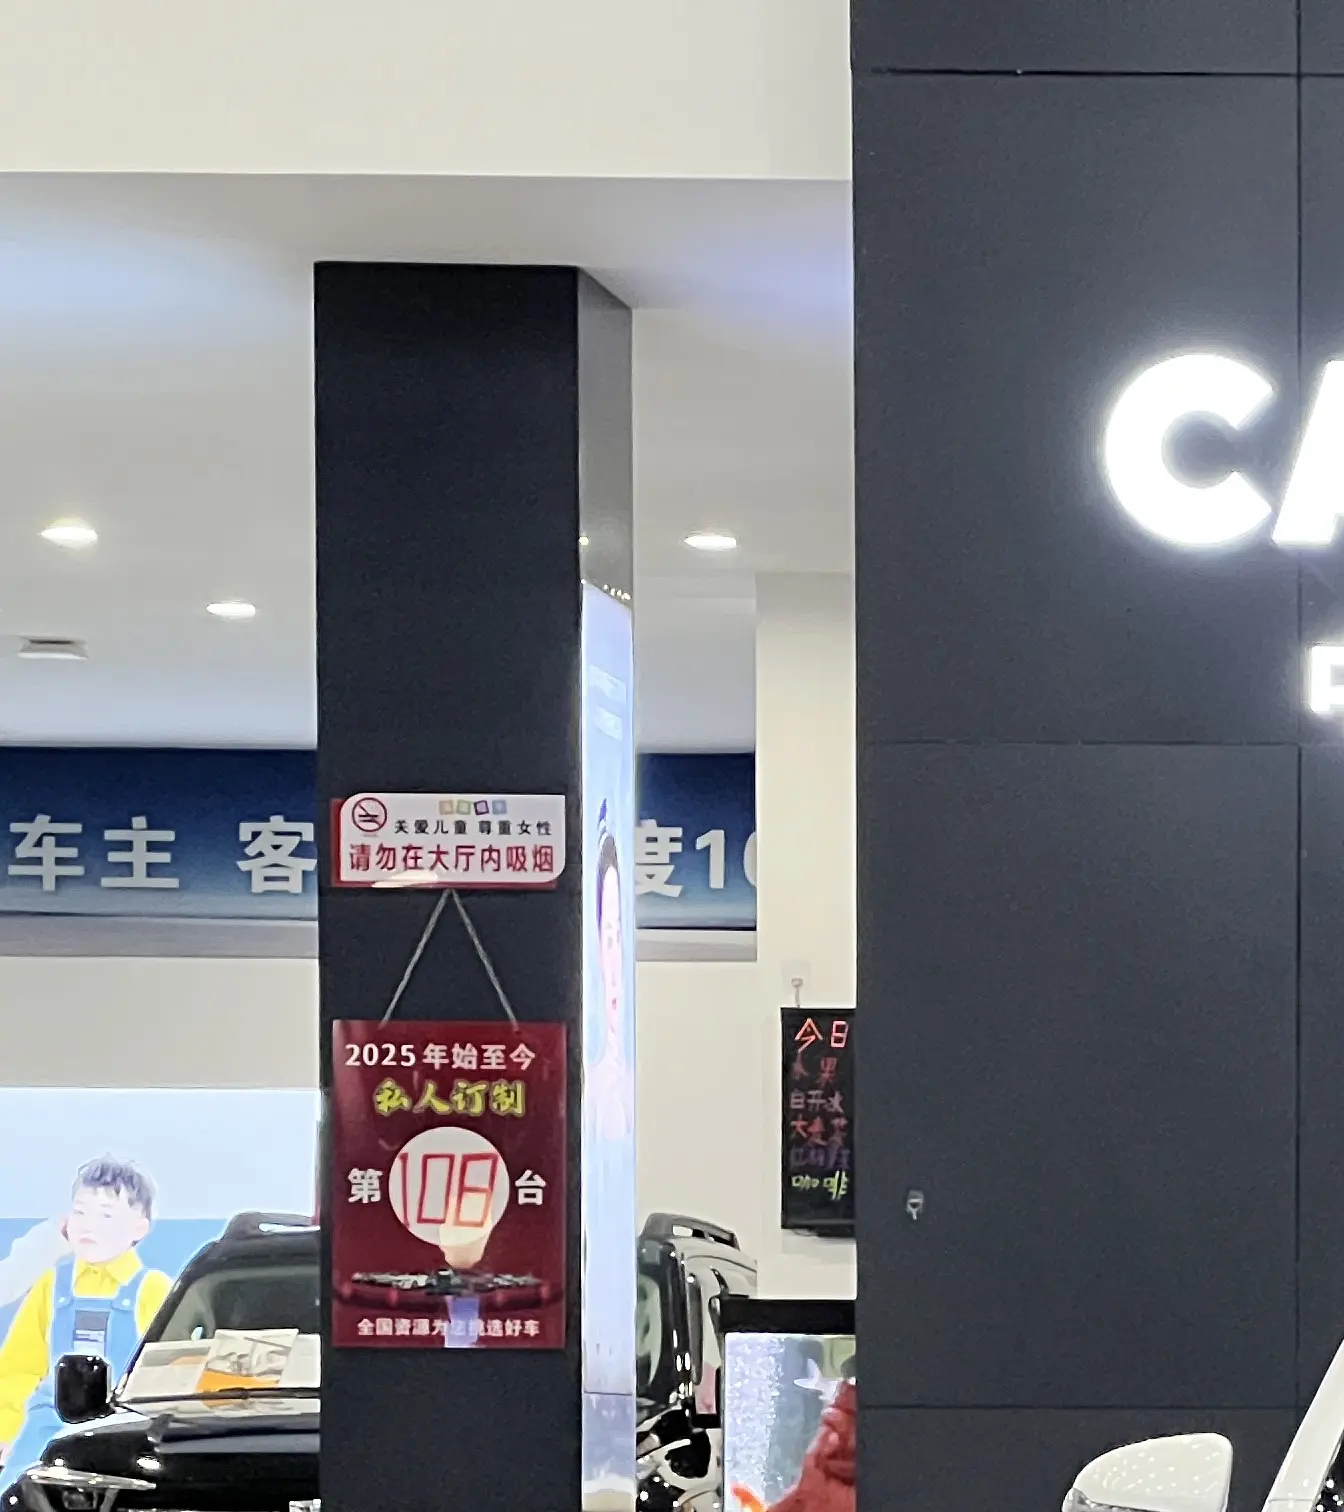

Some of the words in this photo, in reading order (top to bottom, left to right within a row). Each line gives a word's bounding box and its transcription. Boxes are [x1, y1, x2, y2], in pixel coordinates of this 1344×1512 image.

[394, 819, 468, 835] 关爱儿童
[478, 819, 553, 836] 尊重女性
[8, 814, 180, 892] 车主
[349, 843, 554, 873] 请勿在大厅内吸烟
[374, 1078, 526, 1116] 私人订制
[347, 1167, 383, 1205] 第
[514, 1169, 547, 1206] 台
